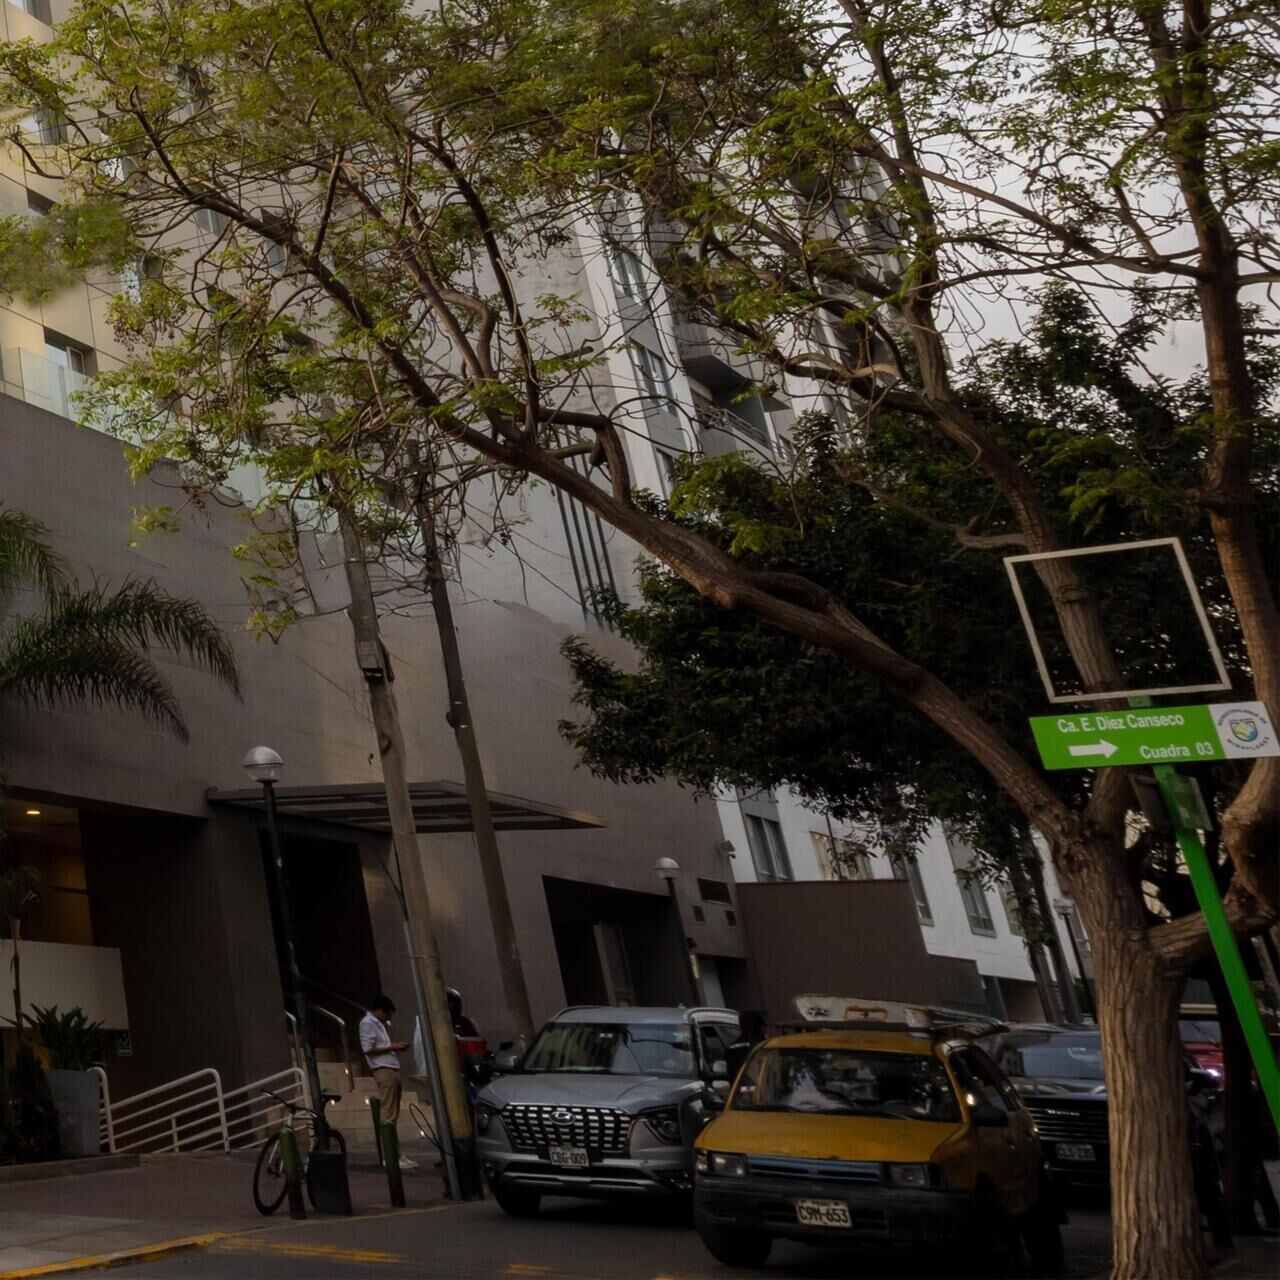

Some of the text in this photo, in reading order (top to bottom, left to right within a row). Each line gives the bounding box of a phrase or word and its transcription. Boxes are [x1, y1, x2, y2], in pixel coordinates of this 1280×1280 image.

[1057, 713, 1184, 733] Ca. E. Diez Canseco
[1140, 741, 1214, 759] Cuadra 03
[799, 1204, 849, 1225] C9M-653
